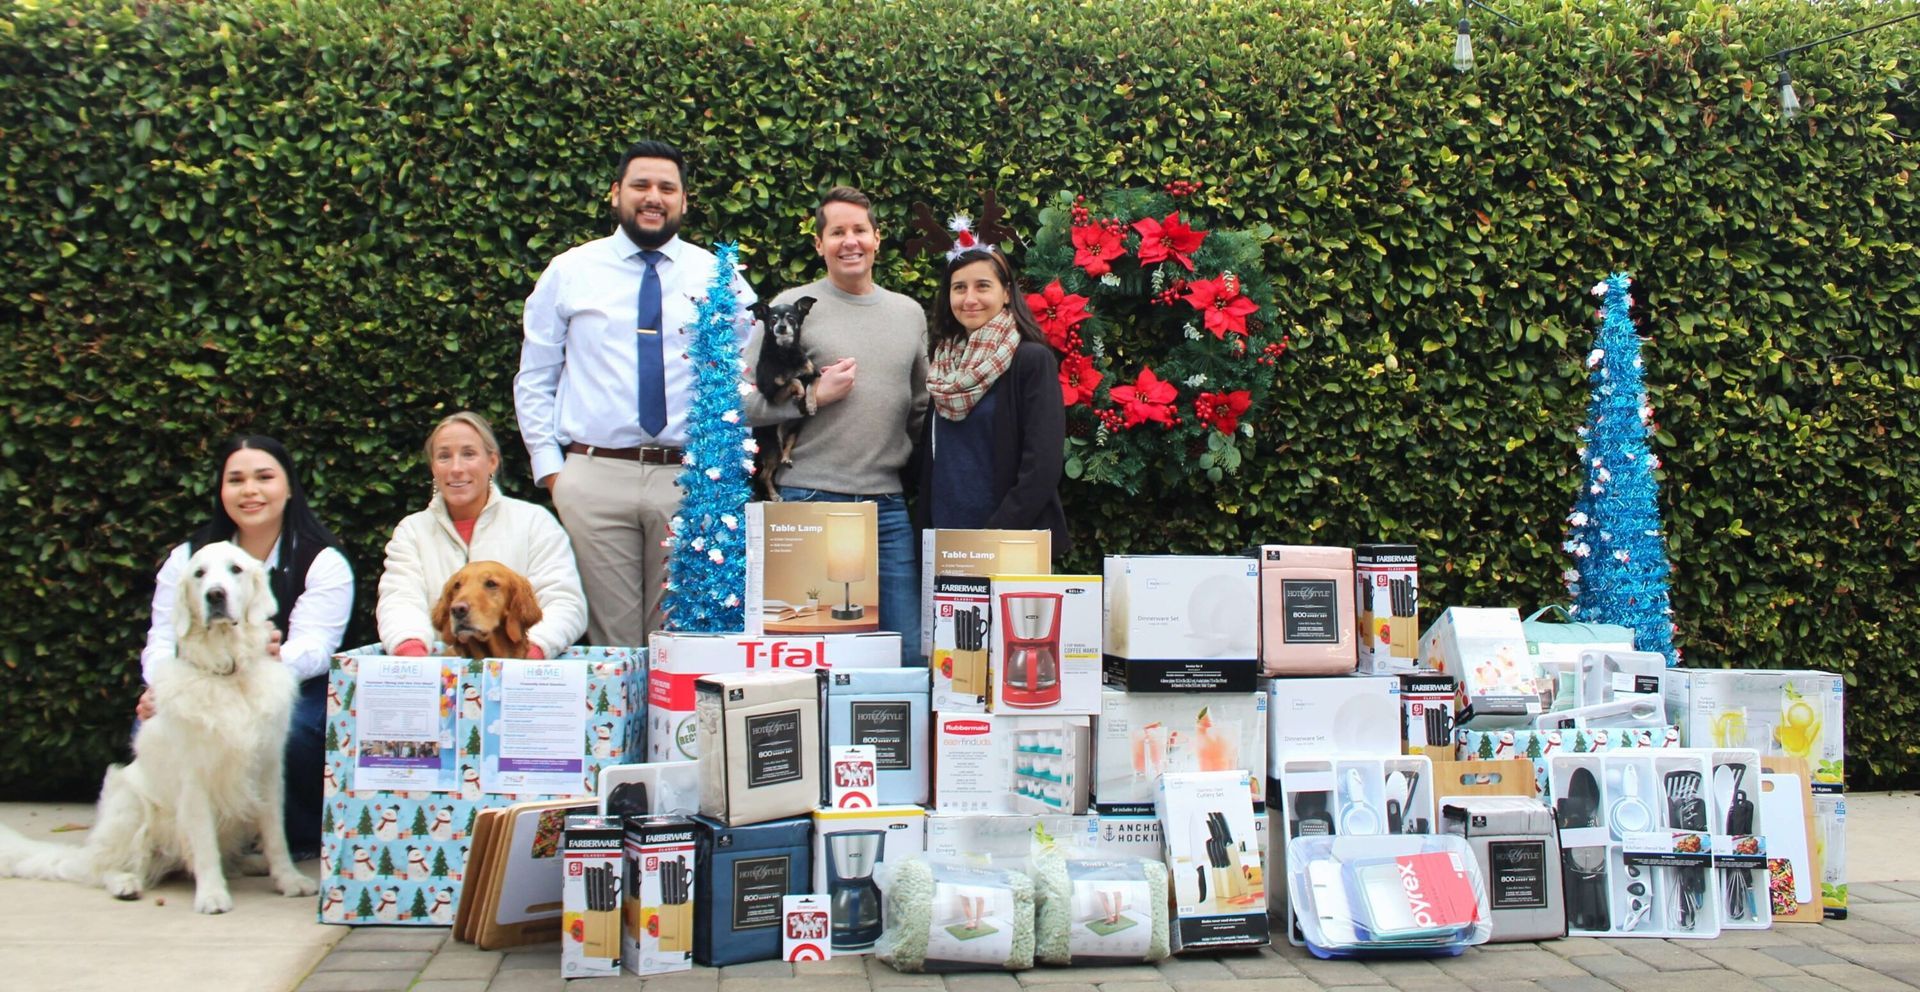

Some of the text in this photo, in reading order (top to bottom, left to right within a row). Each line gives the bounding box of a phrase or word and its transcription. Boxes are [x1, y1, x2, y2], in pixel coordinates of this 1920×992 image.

[769, 524, 823, 534] Table Lamp
[941, 551, 996, 560] Table Lamp
[1247, 563, 1257, 572] 12
[941, 583, 988, 593] FARBERWARE
[737, 641, 833, 669] T-fal
[1389, 681, 1398, 689] 12
[1833, 680, 1841, 688] 16
[1257, 697, 1266, 705] 16
[758, 750, 773, 758] 800
[1836, 801, 1845, 809] 16
[1088, 818, 1097, 827] 16
[645, 832, 693, 843] FARBERWARE
[568, 839, 621, 848] FARBERWARE
[743, 894, 758, 902] 800
[1397, 860, 1438, 928] pyrex
